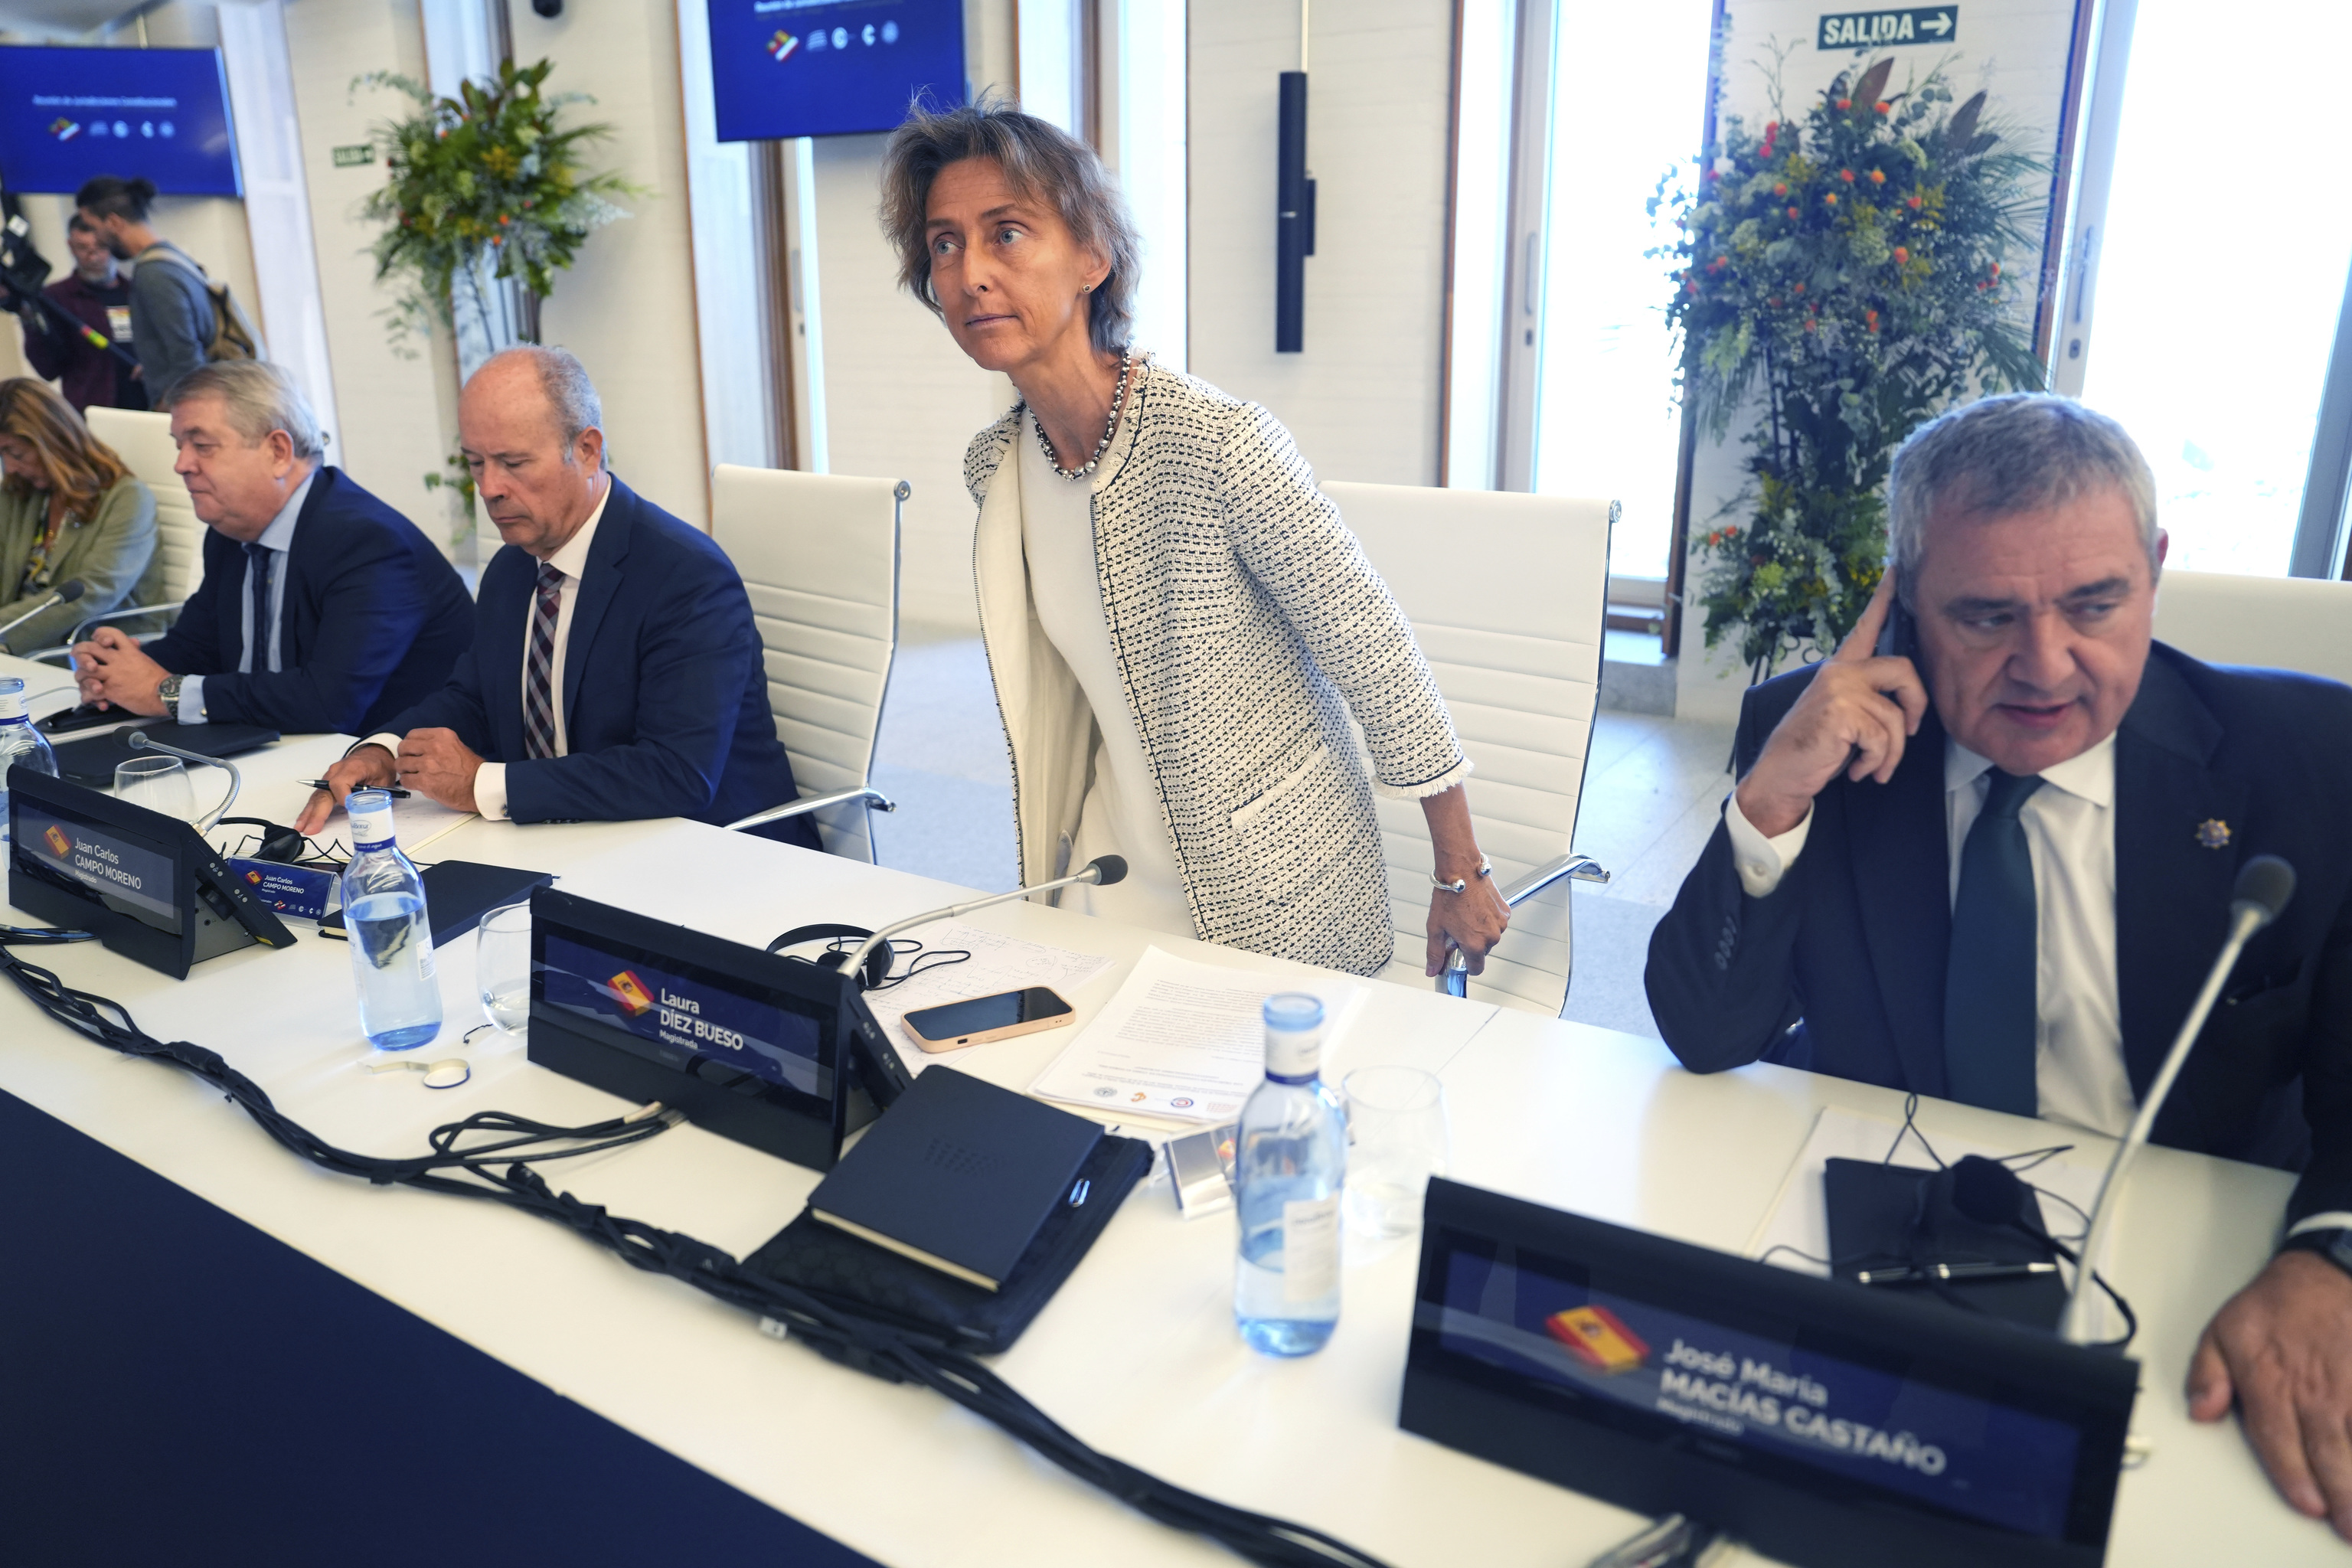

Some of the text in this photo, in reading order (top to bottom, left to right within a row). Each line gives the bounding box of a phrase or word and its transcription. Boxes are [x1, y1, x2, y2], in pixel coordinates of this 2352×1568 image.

[1824, 13, 1915, 45] SALIDA
[75, 837, 119, 864] Juan Carlos
[75, 854, 142, 890] CAMPO MORENO
[75, 869, 97, 884] Magistrado
[276, 877, 293, 885] Carlos
[263, 881, 305, 894] CAMPO MORENO
[661, 988, 700, 1014] Laura
[659, 1029, 698, 1050] Magistrada
[660, 1008, 744, 1051] DÍEZ BUESO
[1664, 1338, 1829, 1409] José María
[1659, 1367, 1948, 1477] MACÍAS CASTAÑO
